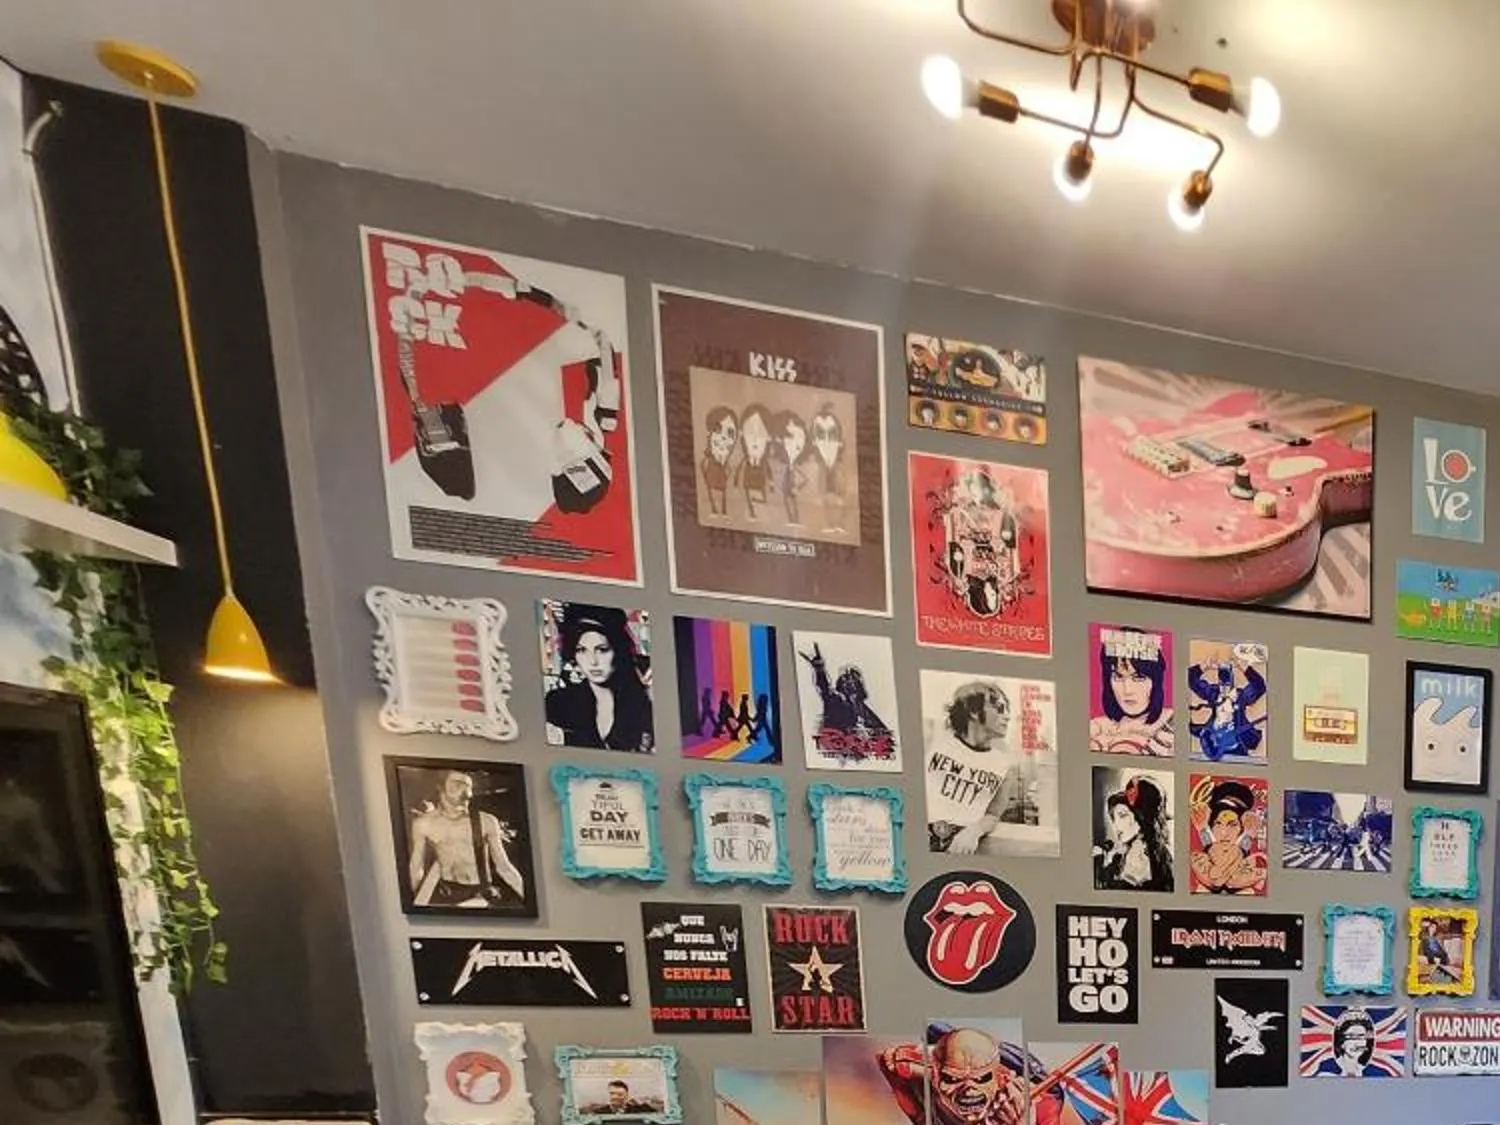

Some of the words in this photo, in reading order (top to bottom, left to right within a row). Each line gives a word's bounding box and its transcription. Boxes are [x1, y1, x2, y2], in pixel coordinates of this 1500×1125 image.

[749, 351, 797, 383] KISS
[1422, 677, 1477, 698] milk
[928, 752, 965, 775] NEW
[941, 773, 983, 806] CITY
[590, 810, 628, 823] DAY
[580, 827, 604, 840] GET
[607, 828, 640, 842] AWAY
[774, 909, 850, 945] ROCK
[1068, 915, 1128, 939] HEY
[1068, 937, 1129, 968] HO
[451, 942, 599, 1000] METALLICA
[662, 967, 732, 981] CERVEJA
[1067, 966, 1129, 985] LET'S
[780, 994, 855, 1026] STAR
[1068, 984, 1129, 1014] GO
[1419, 1045, 1457, 1067] ROCK
